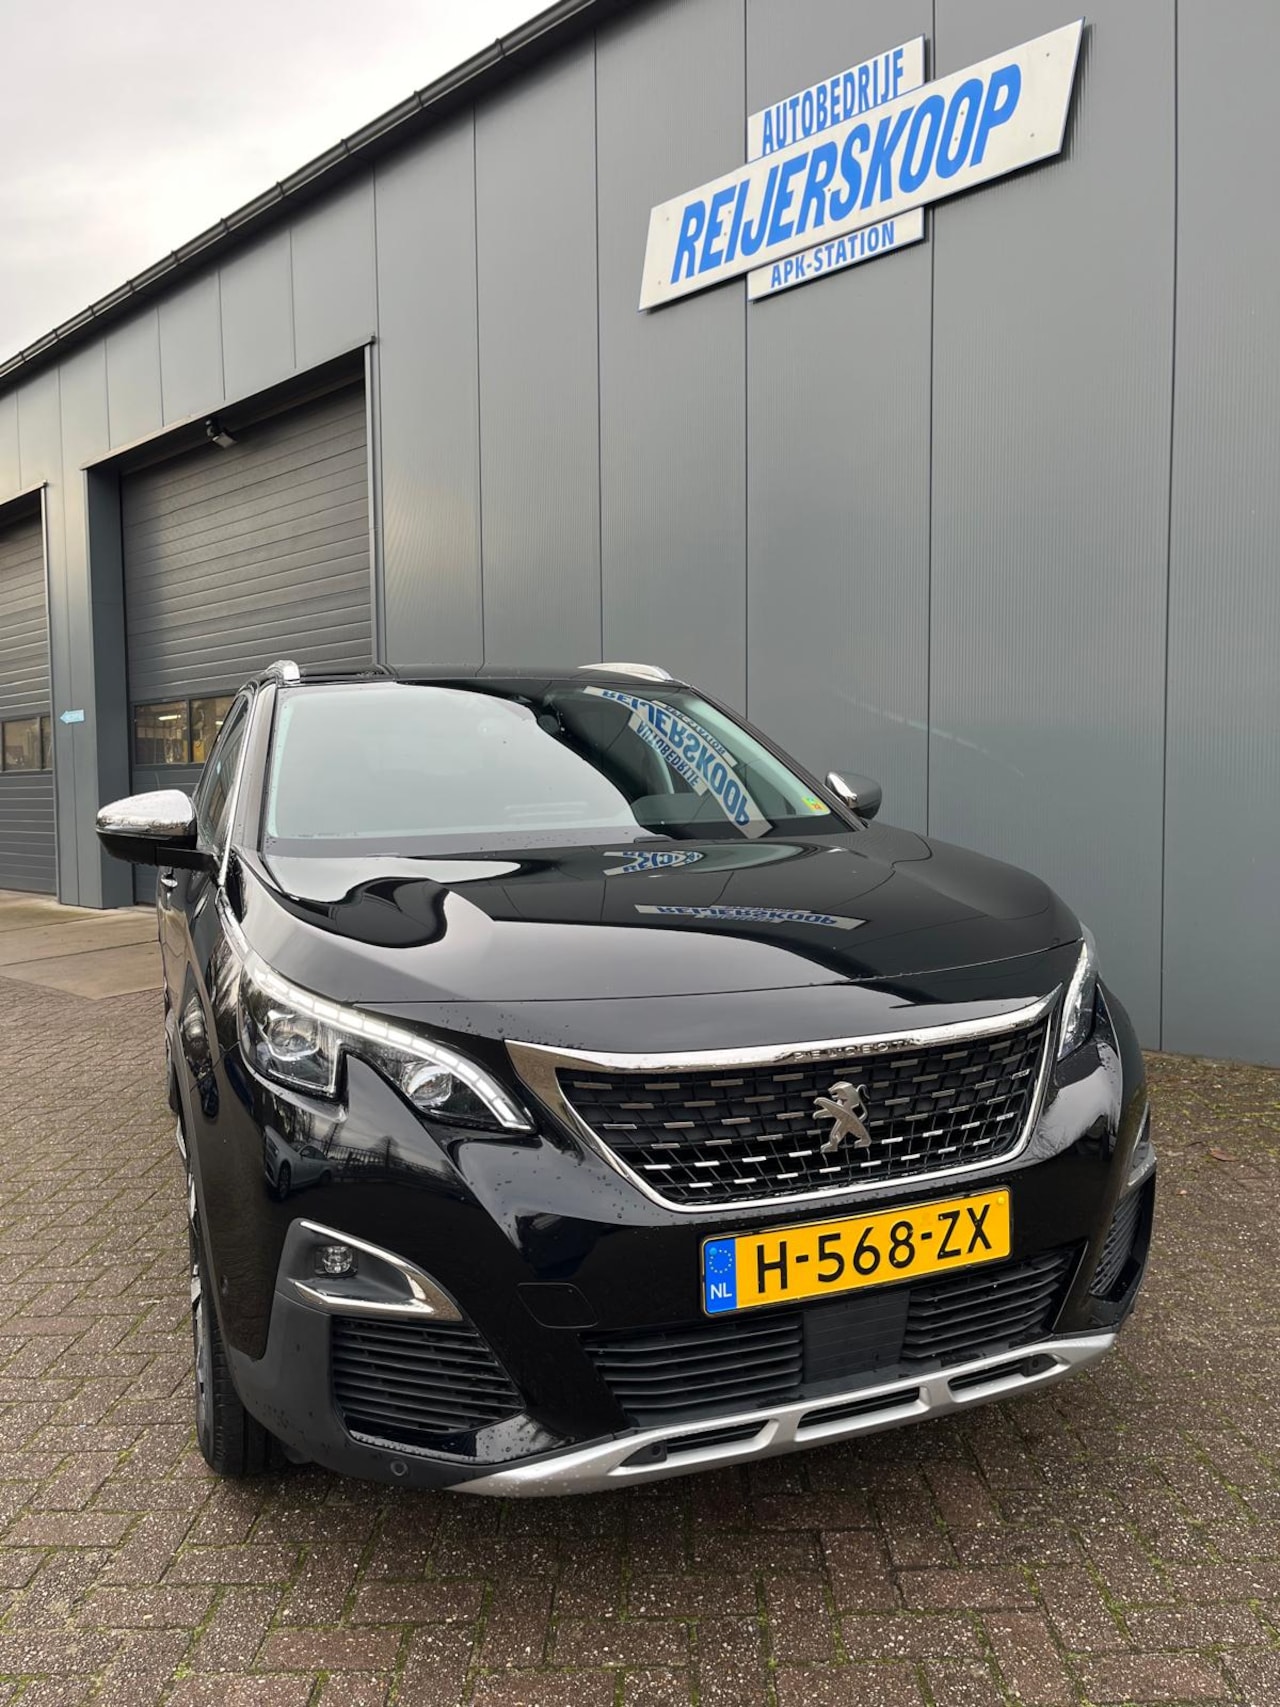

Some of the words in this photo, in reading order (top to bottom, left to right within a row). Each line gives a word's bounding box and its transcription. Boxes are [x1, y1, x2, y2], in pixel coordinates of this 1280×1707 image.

[762, 47, 904, 155] AUTOBEDRIJF
[670, 63, 1022, 285] REIJERSKOOP
[770, 220, 895, 288] APK-STATION
[710, 1281, 732, 1300] NL
[756, 1204, 992, 1294] H-568-ZX
